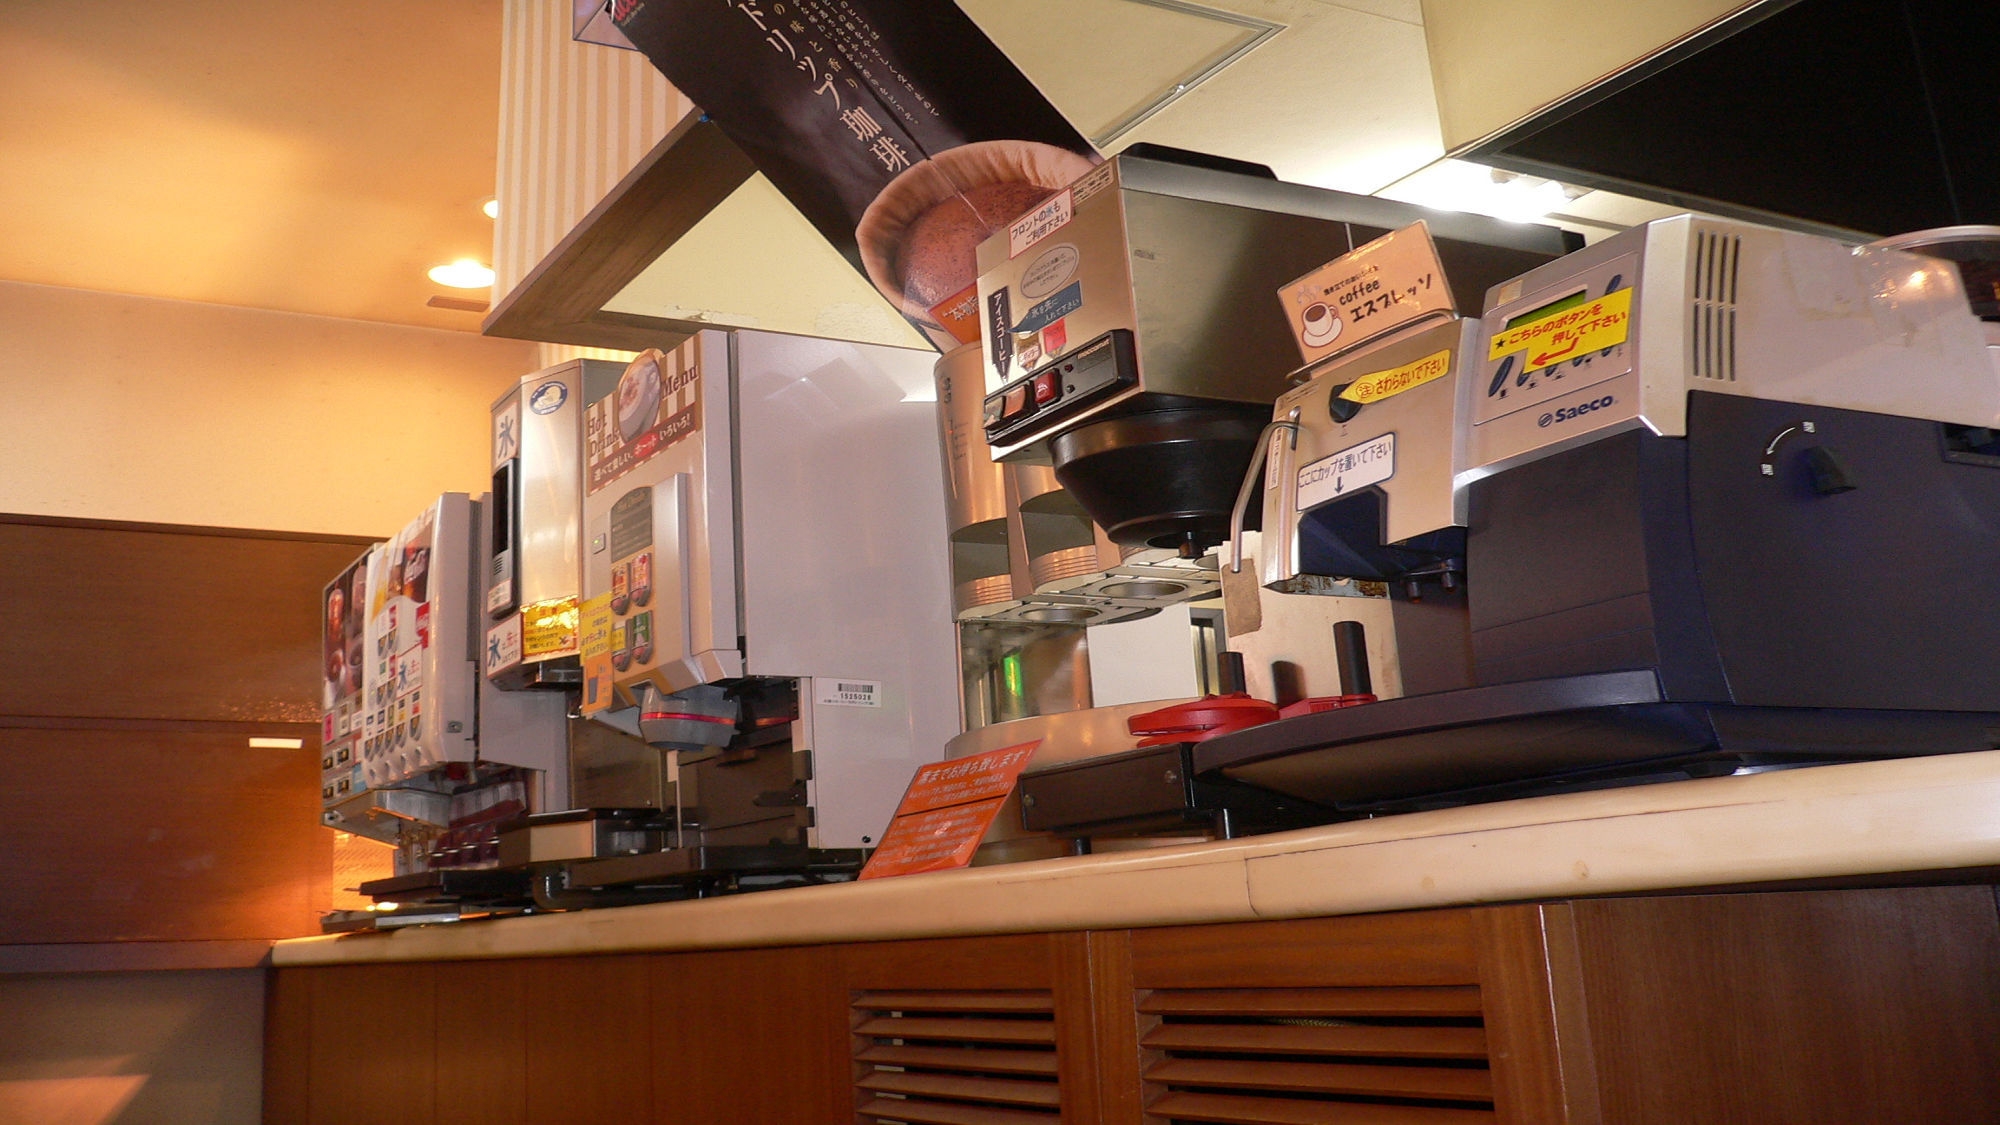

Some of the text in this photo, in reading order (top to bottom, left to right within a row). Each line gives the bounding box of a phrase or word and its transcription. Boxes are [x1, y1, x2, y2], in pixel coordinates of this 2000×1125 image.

[727, 0, 911, 173] ドリップ珈琲
[1025, 211, 1069, 246] ご利用下さい
[1339, 278, 1381, 306] coffee
[1350, 273, 1432, 323] エスプレッソ
[993, 291, 1008, 376] アイスコーヒー
[1508, 302, 1604, 345] こちらのボタンを
[1551, 311, 1626, 346] 押して下さい
[661, 364, 700, 399] Menu
[586, 413, 608, 438] Hot
[1555, 394, 1615, 424] Saeco
[498, 415, 515, 459] 氷
[1298, 441, 1392, 489] ここにカップを置いて下さい
